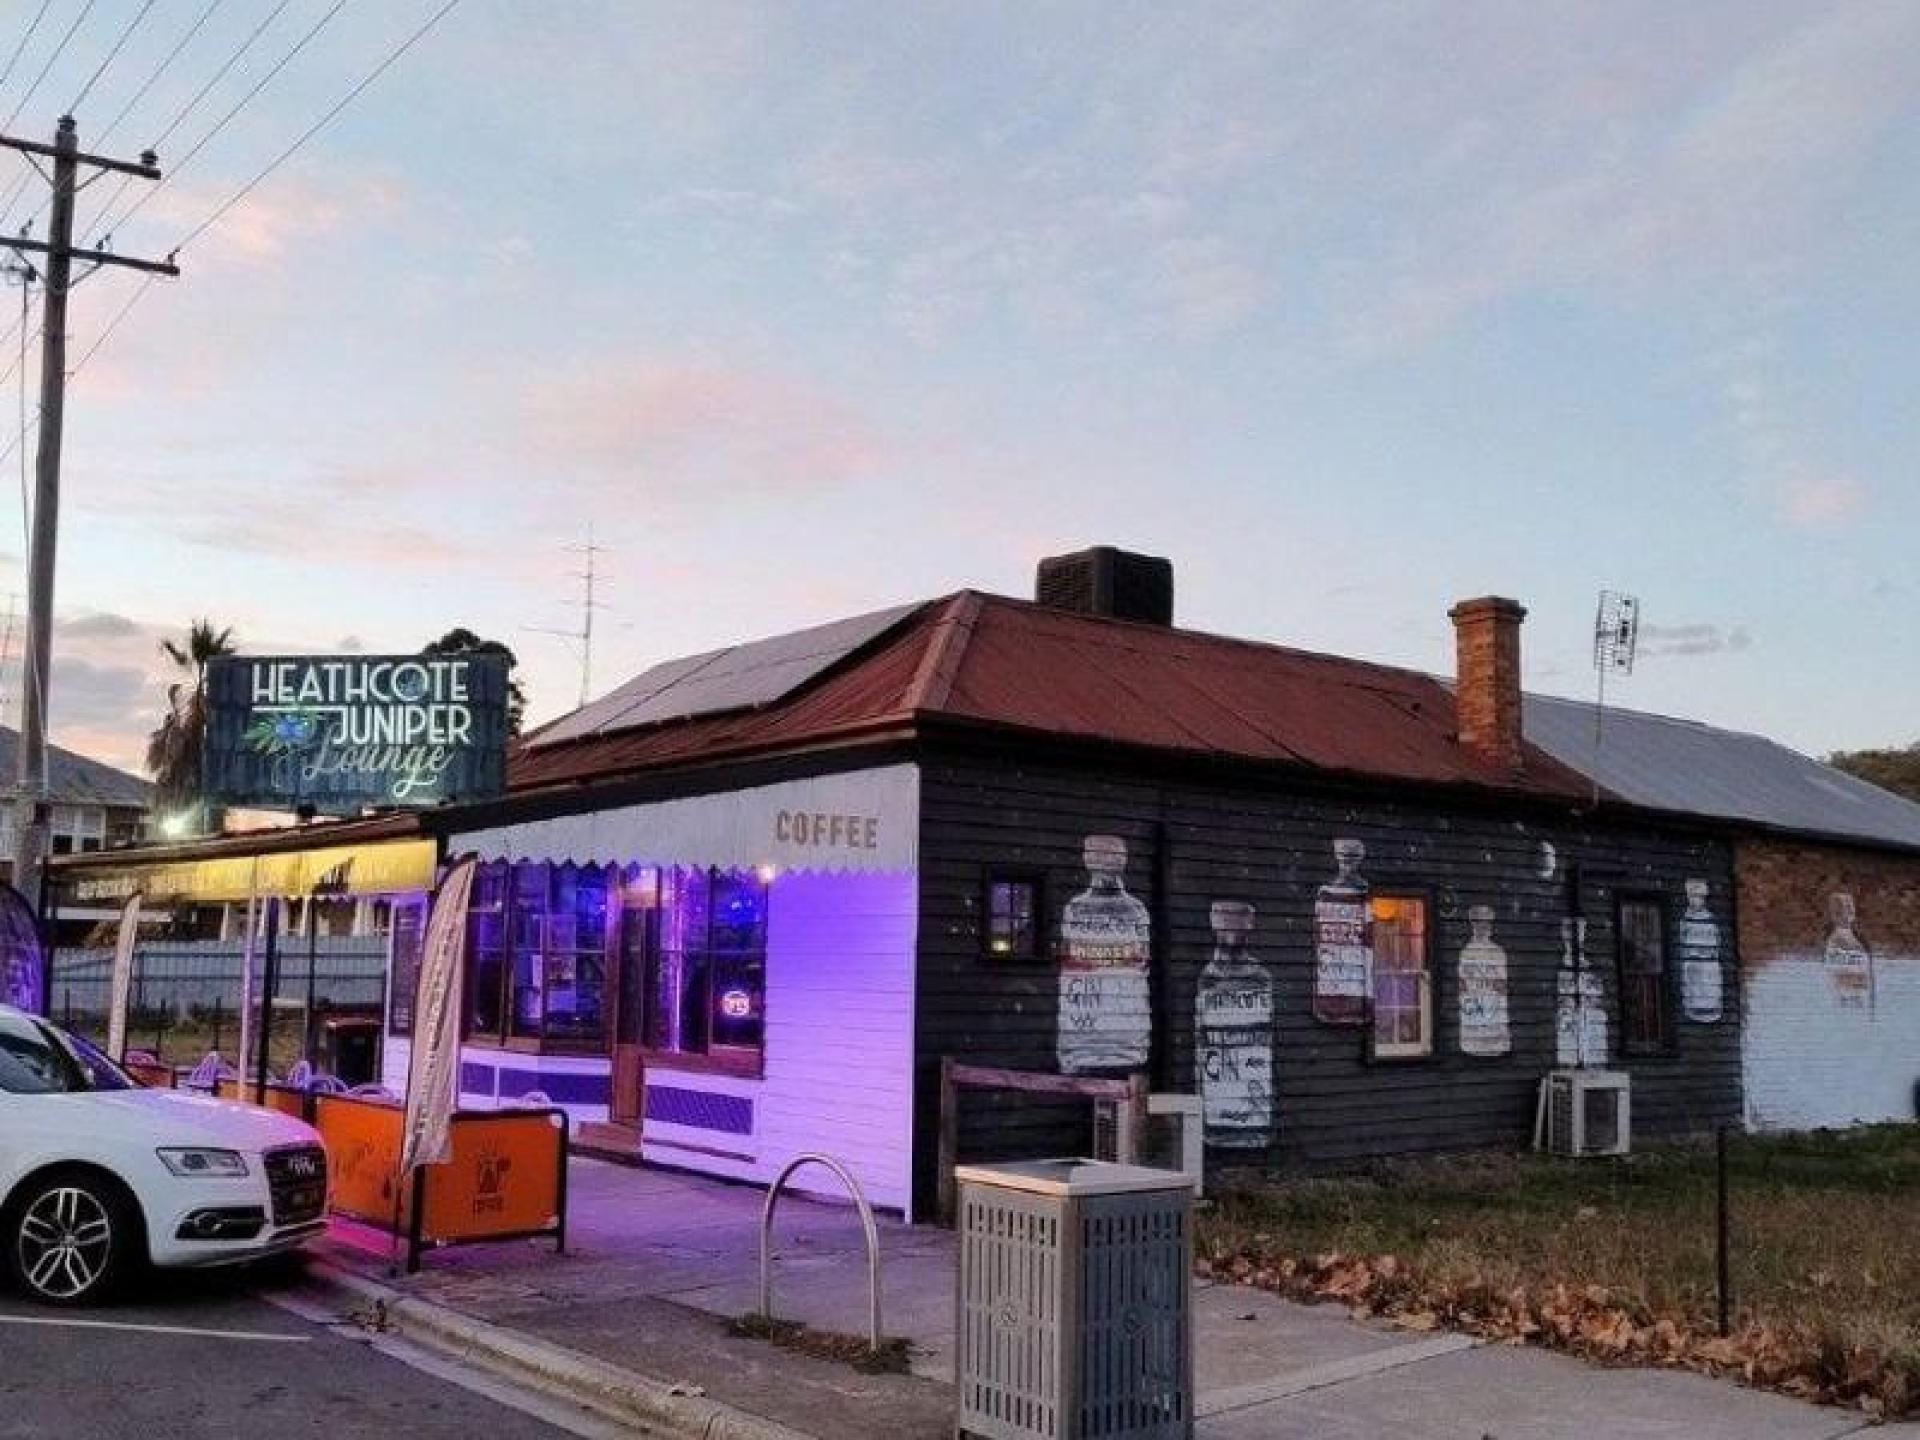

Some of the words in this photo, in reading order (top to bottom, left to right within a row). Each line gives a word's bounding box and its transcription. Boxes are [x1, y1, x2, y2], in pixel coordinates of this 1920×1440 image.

[252, 661, 470, 702] HEATHCOTE
[333, 705, 471, 745] JUNIPER
[301, 718, 457, 798] Lounge
[776, 809, 880, 848] COFFEE
